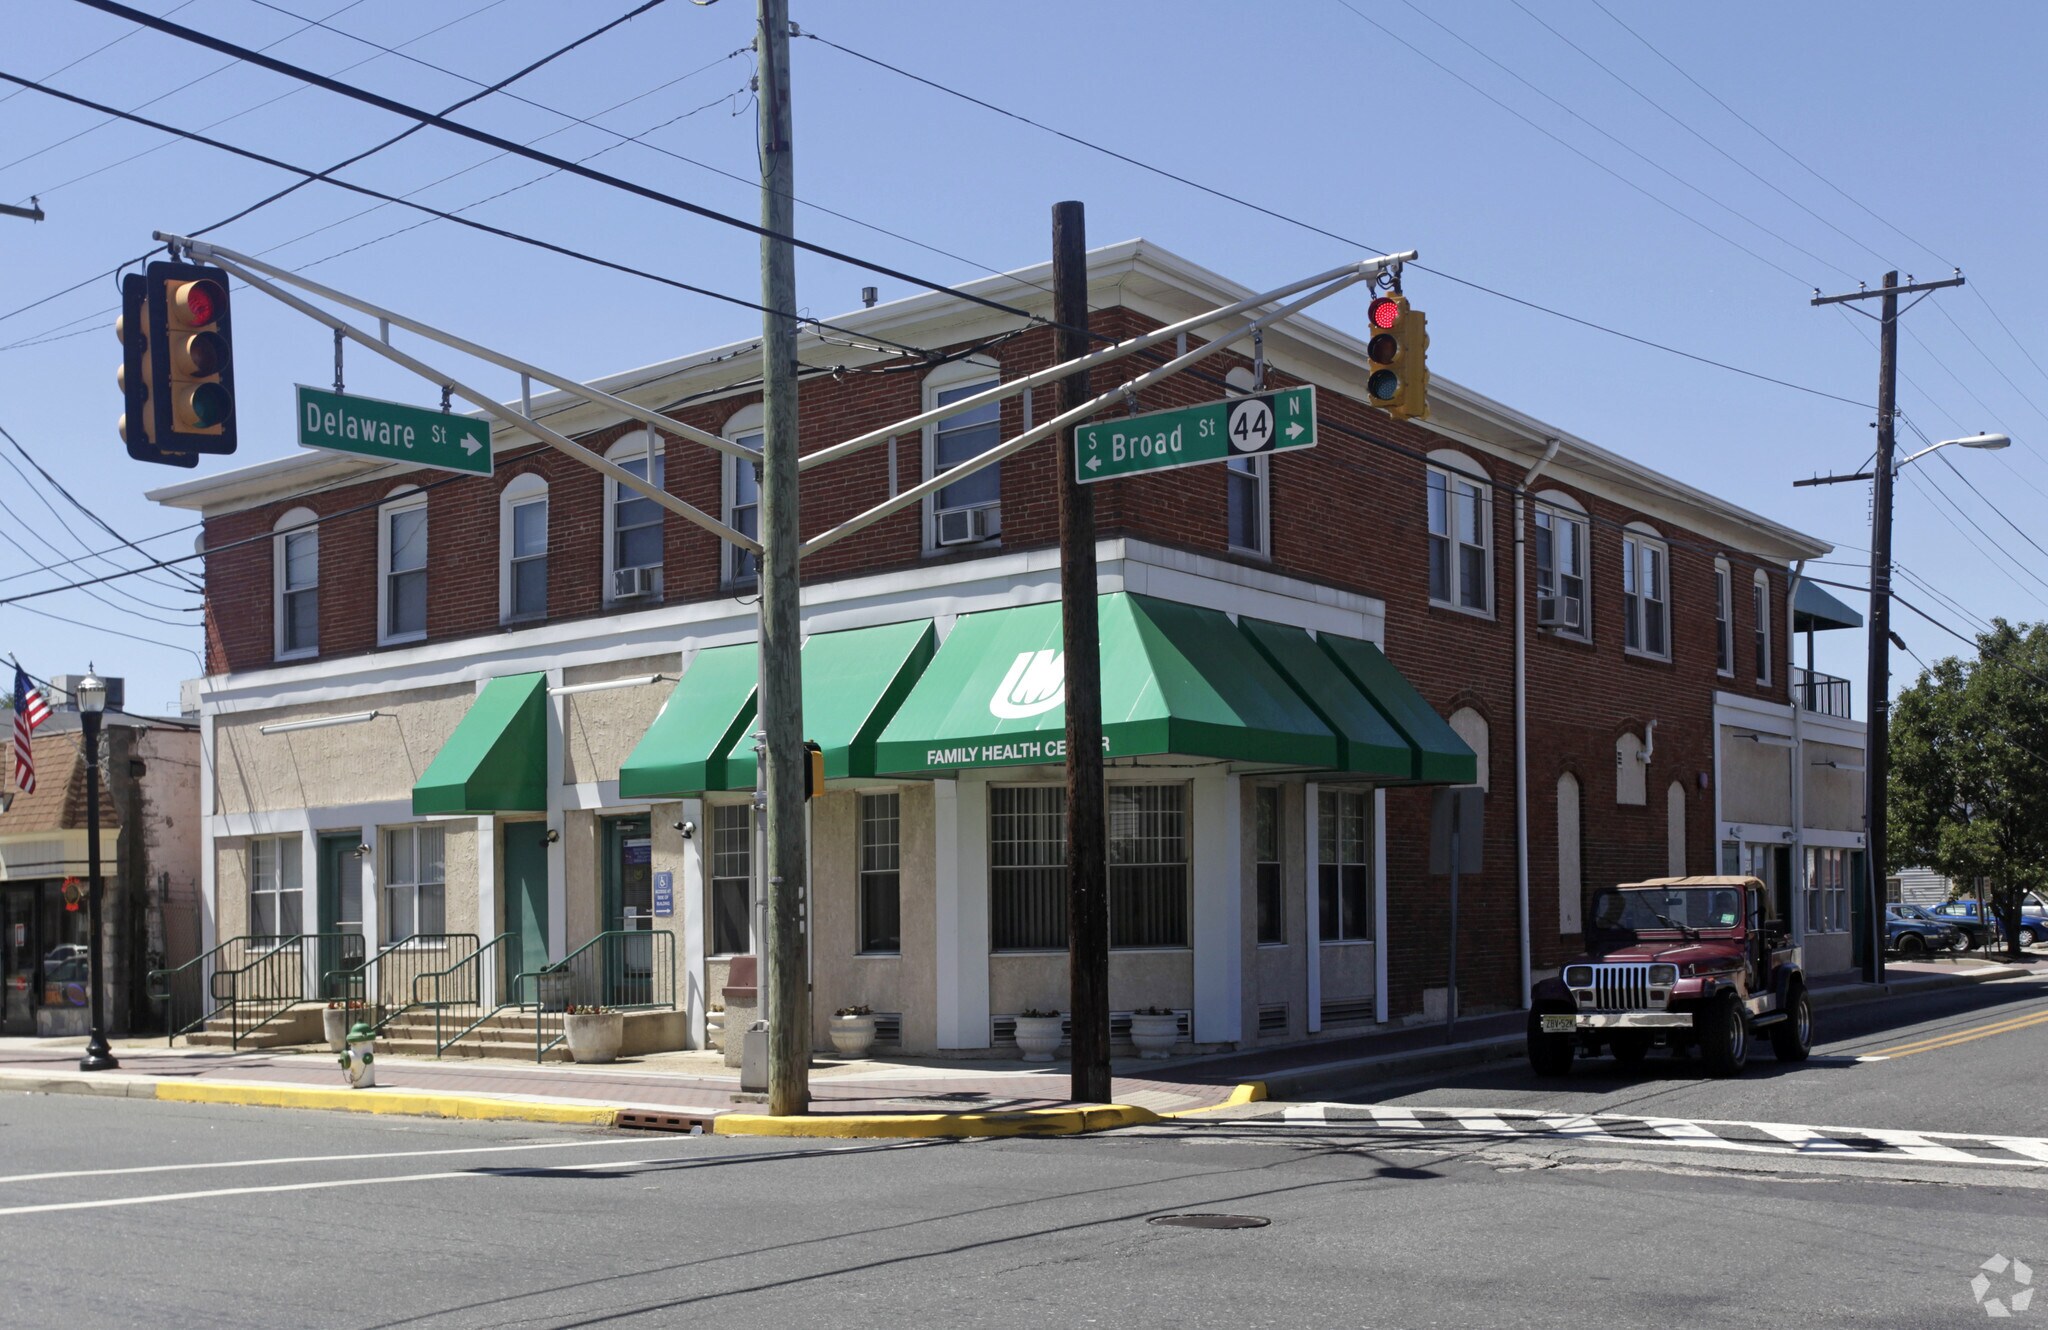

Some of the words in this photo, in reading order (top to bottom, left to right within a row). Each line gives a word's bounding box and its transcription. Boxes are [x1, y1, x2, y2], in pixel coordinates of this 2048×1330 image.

[1289, 396, 1300, 416] N
[306, 402, 415, 449] Delaware
[431, 424, 447, 444] St
[1088, 432, 1097, 450] S
[1112, 423, 1182, 462] Broad
[1199, 418, 1215, 438] St
[1233, 409, 1267, 441] 44
[927, 746, 978, 765] FAMILY
[982, 742, 1041, 761] HEALTH
[1044, 736, 1110, 757] CER
